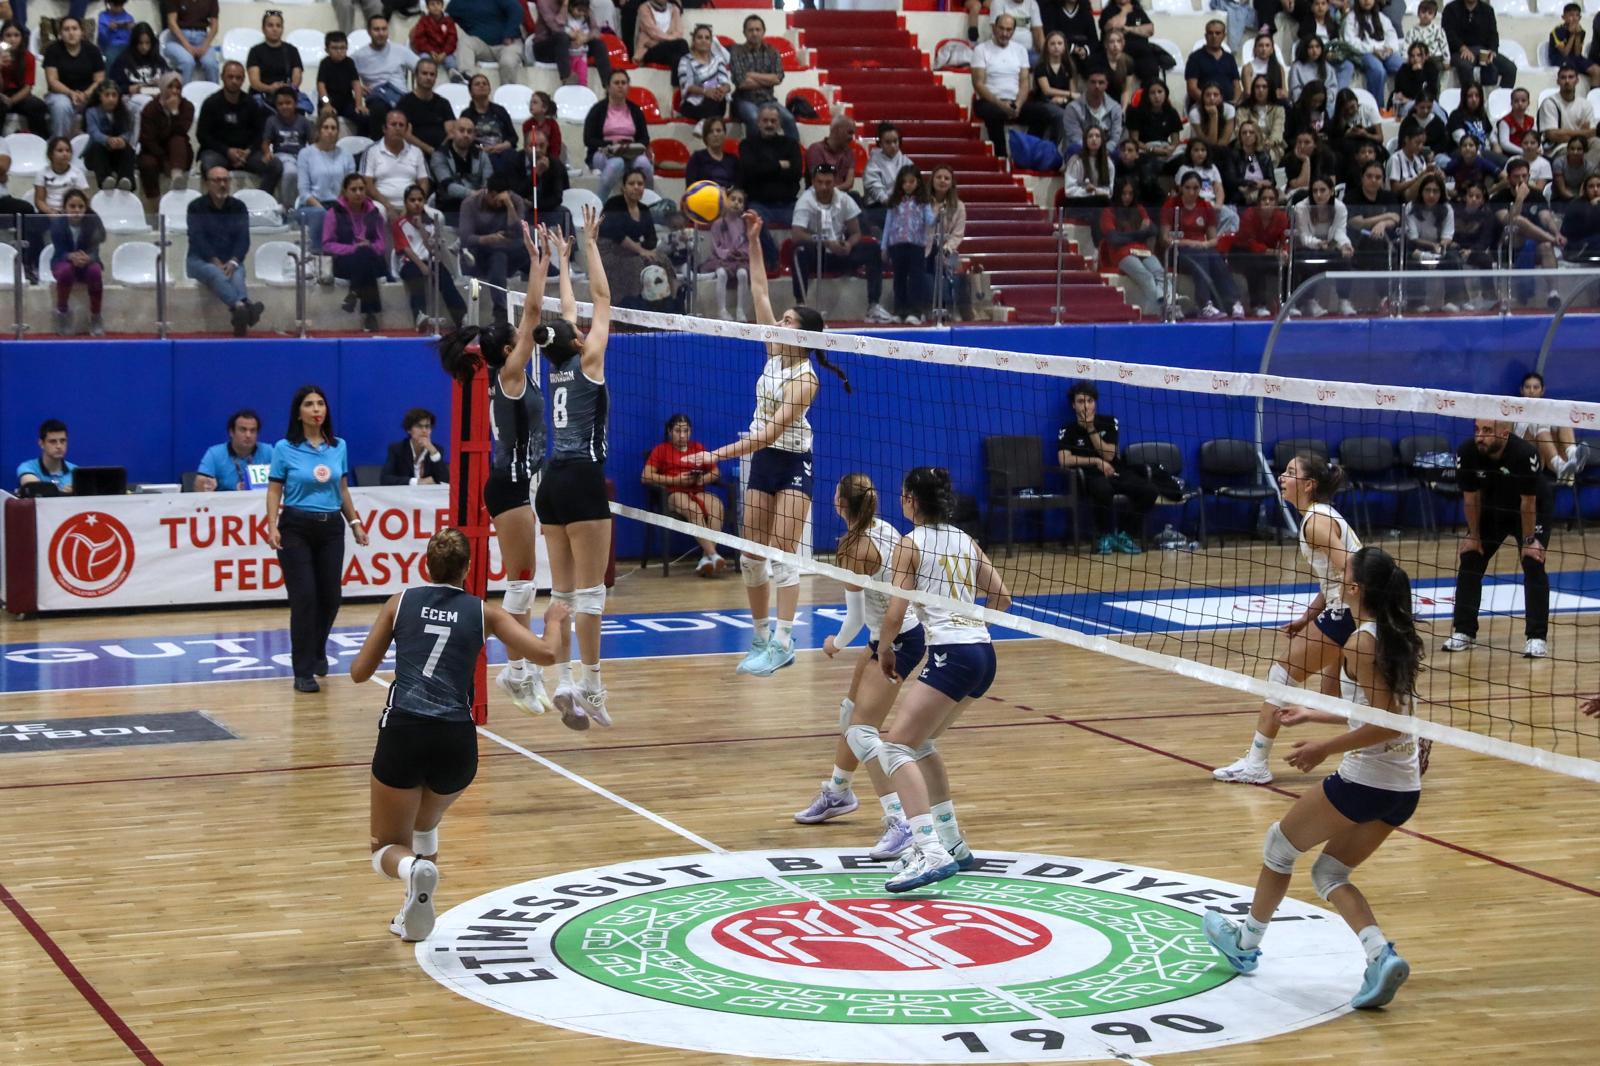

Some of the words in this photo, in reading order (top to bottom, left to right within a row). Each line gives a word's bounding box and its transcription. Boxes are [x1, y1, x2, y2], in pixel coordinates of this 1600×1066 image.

[553, 386, 568, 429] 8
[159, 506, 270, 549] TÜRK
[420, 606, 458, 623] ECEM
[422, 623, 451, 678] 7
[434, 862, 715, 985] ETİMESGUT
[767, 854, 1325, 923] BEEDİYESİ
[942, 1013, 1225, 1054] 1990
